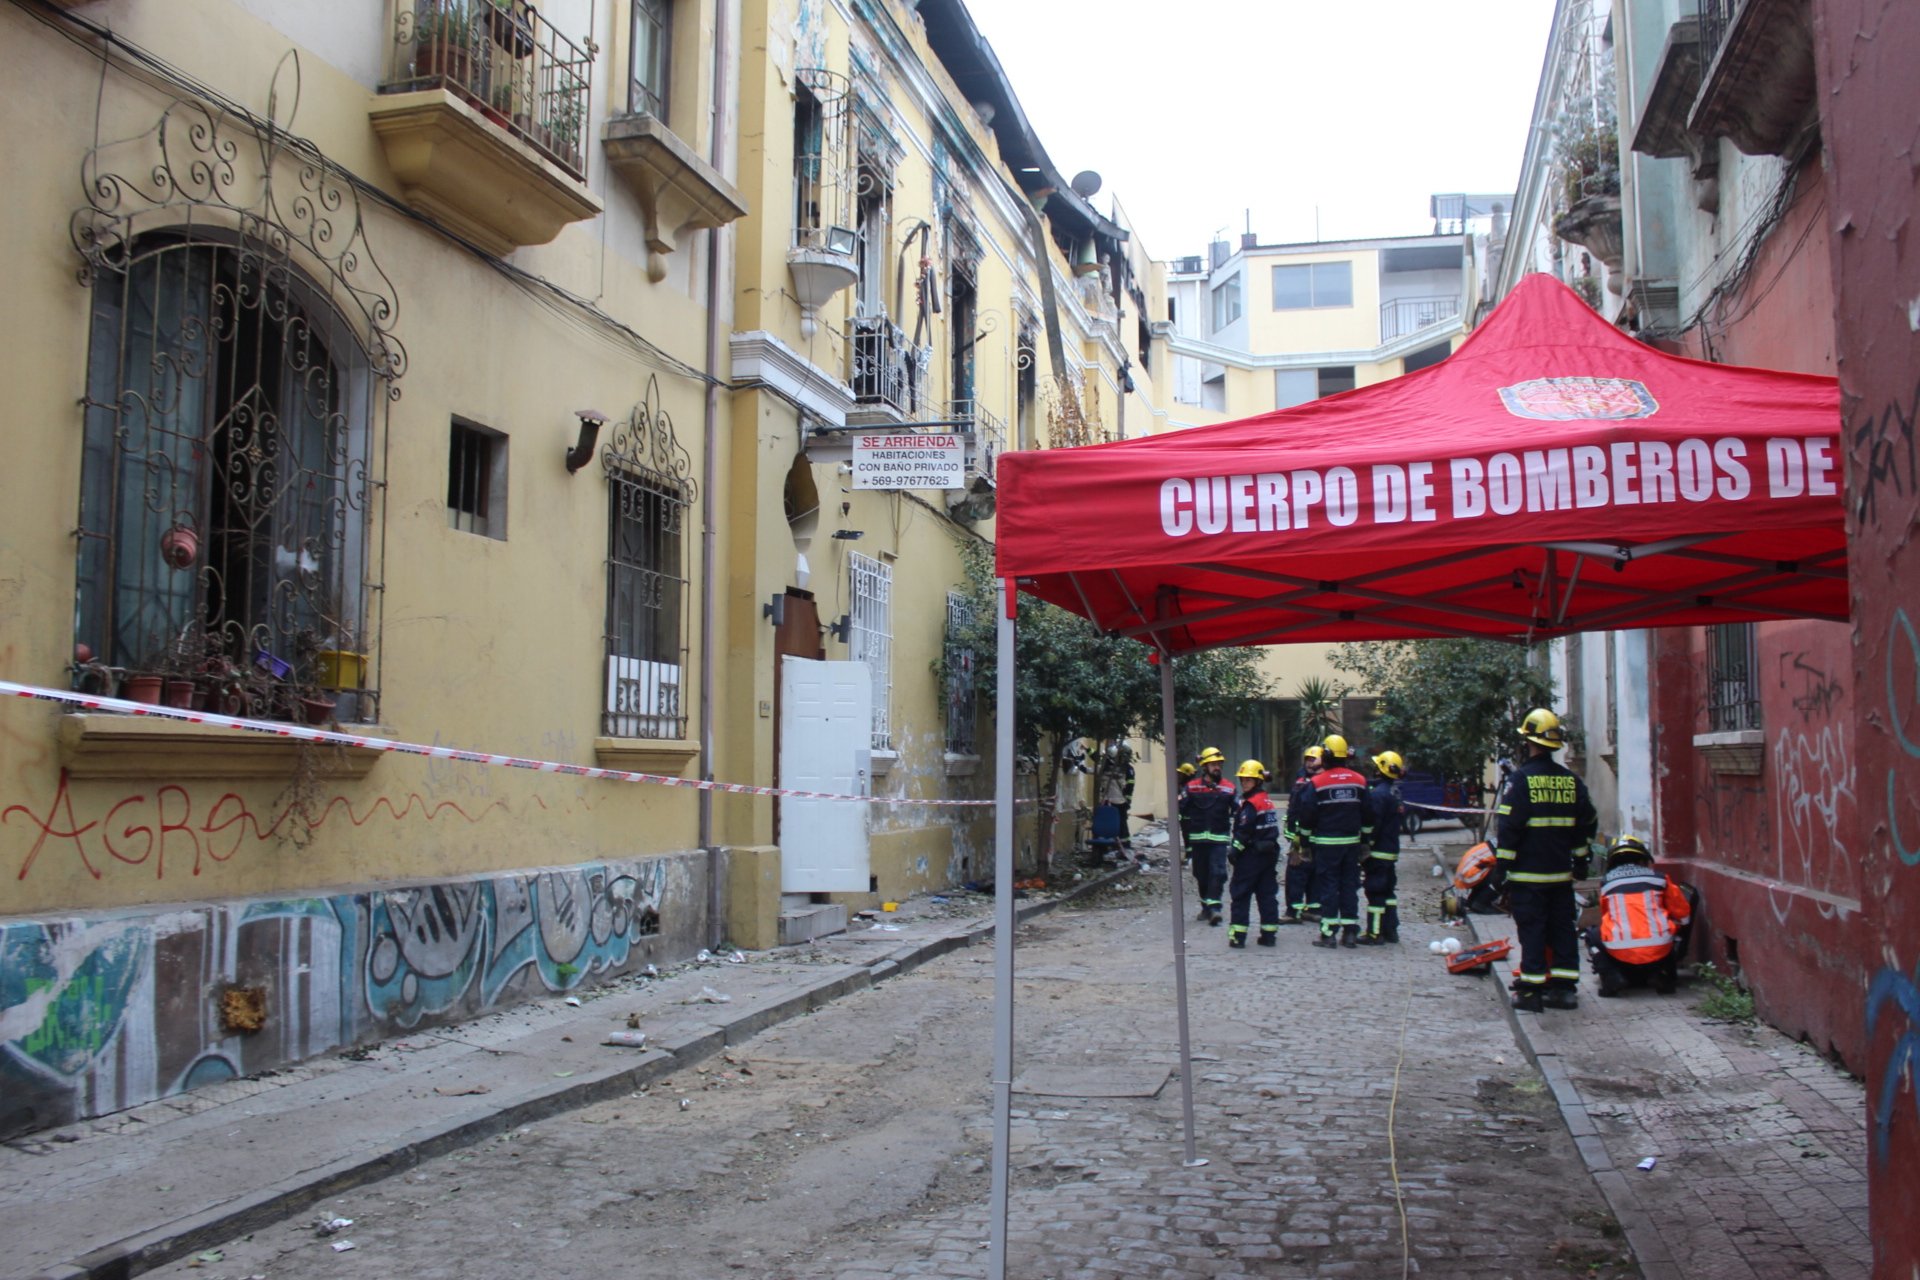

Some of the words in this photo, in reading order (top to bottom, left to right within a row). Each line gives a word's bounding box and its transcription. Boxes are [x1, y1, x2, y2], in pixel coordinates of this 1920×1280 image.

[862, 436, 880, 448] SE
[883, 436, 956, 447] ARRIENDA
[872, 451, 946, 460] HABITACIONES
[858, 463, 881, 472] CON
[883, 461, 912, 472] BAÑO
[914, 463, 959, 472] PRIVADO
[872, 476, 949, 486] 569-97677625
[1160, 466, 1358, 537] CUERPO
[1373, 462, 1437, 524] DE
[1451, 437, 1751, 519] BOMBEROS
[1766, 437, 1837, 498] DE
[1526, 775, 1576, 789] BOMBEROS
[1529, 789, 1577, 803] SANTIAGO
